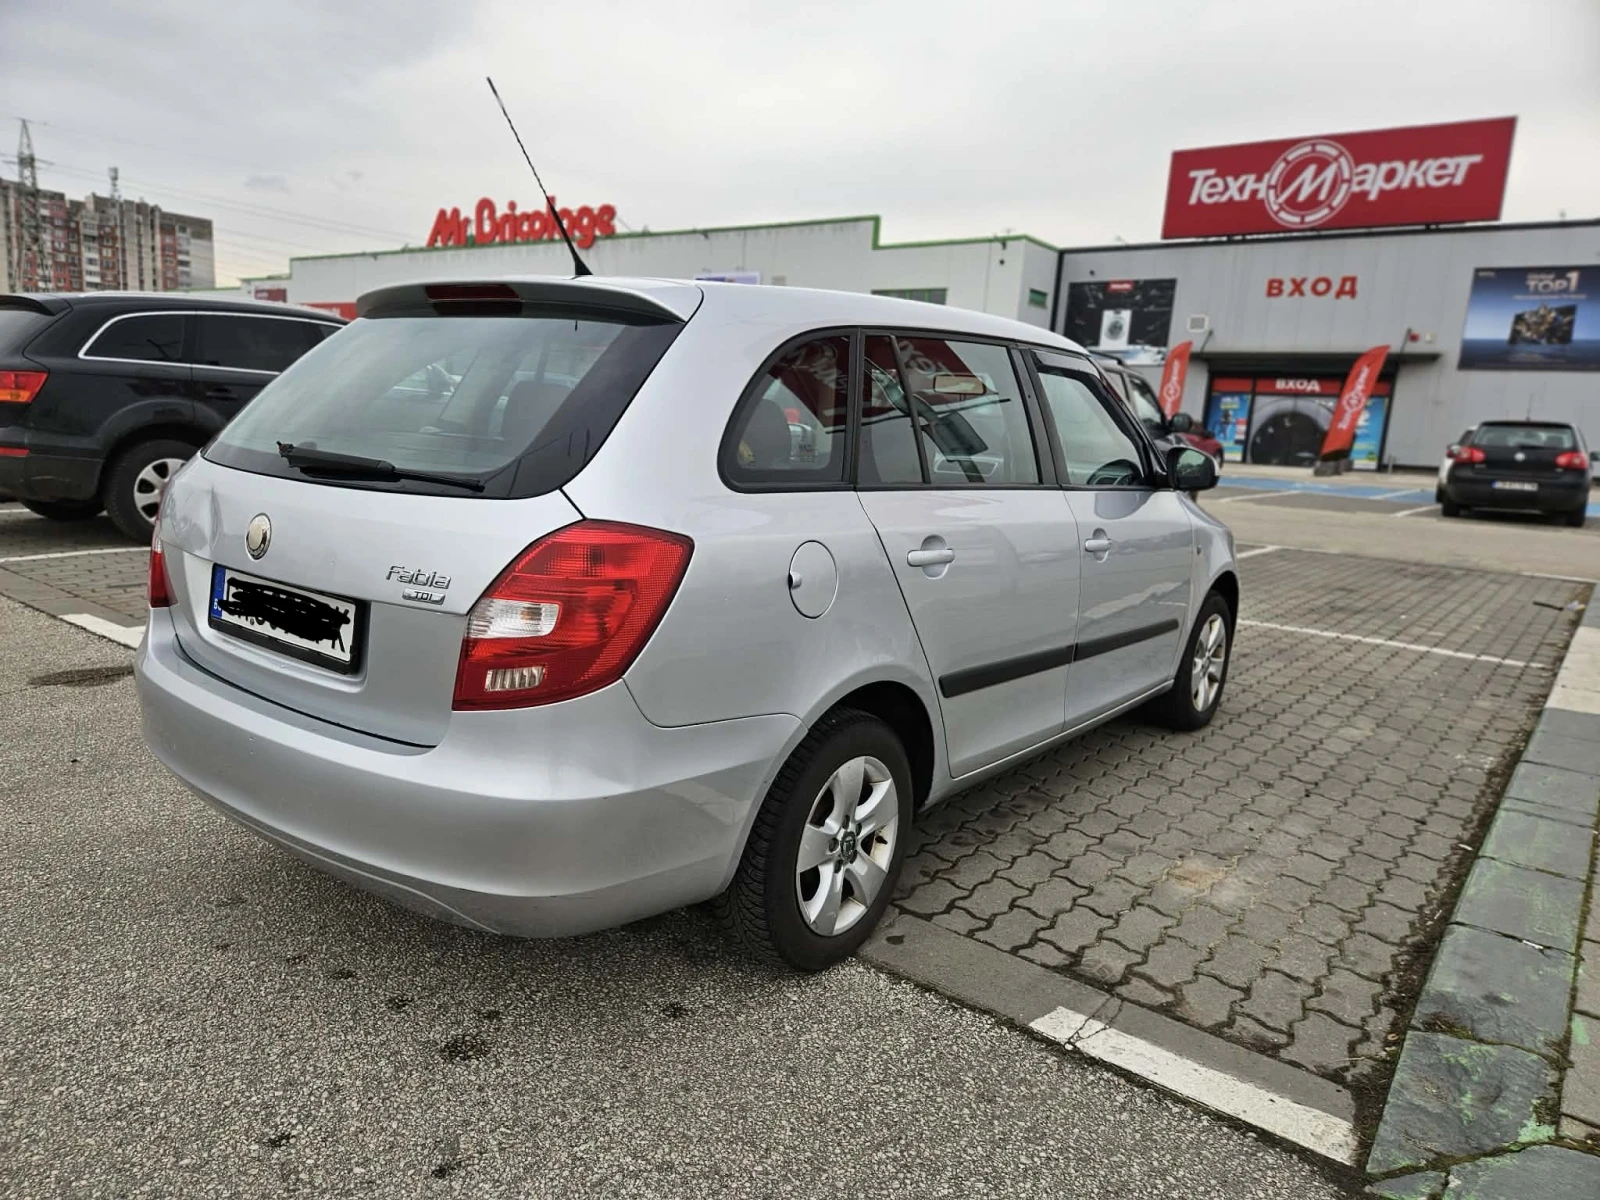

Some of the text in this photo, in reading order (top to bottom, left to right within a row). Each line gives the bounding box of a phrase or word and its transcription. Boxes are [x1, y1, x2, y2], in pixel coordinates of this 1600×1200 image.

[426, 195, 616, 249] Mr Bricolage
[1266, 275, 1358, 300] ВХОД
[1275, 378, 1321, 392] ВХОД
[386, 565, 451, 589] Fabia
[414, 590, 434, 601] TDI
